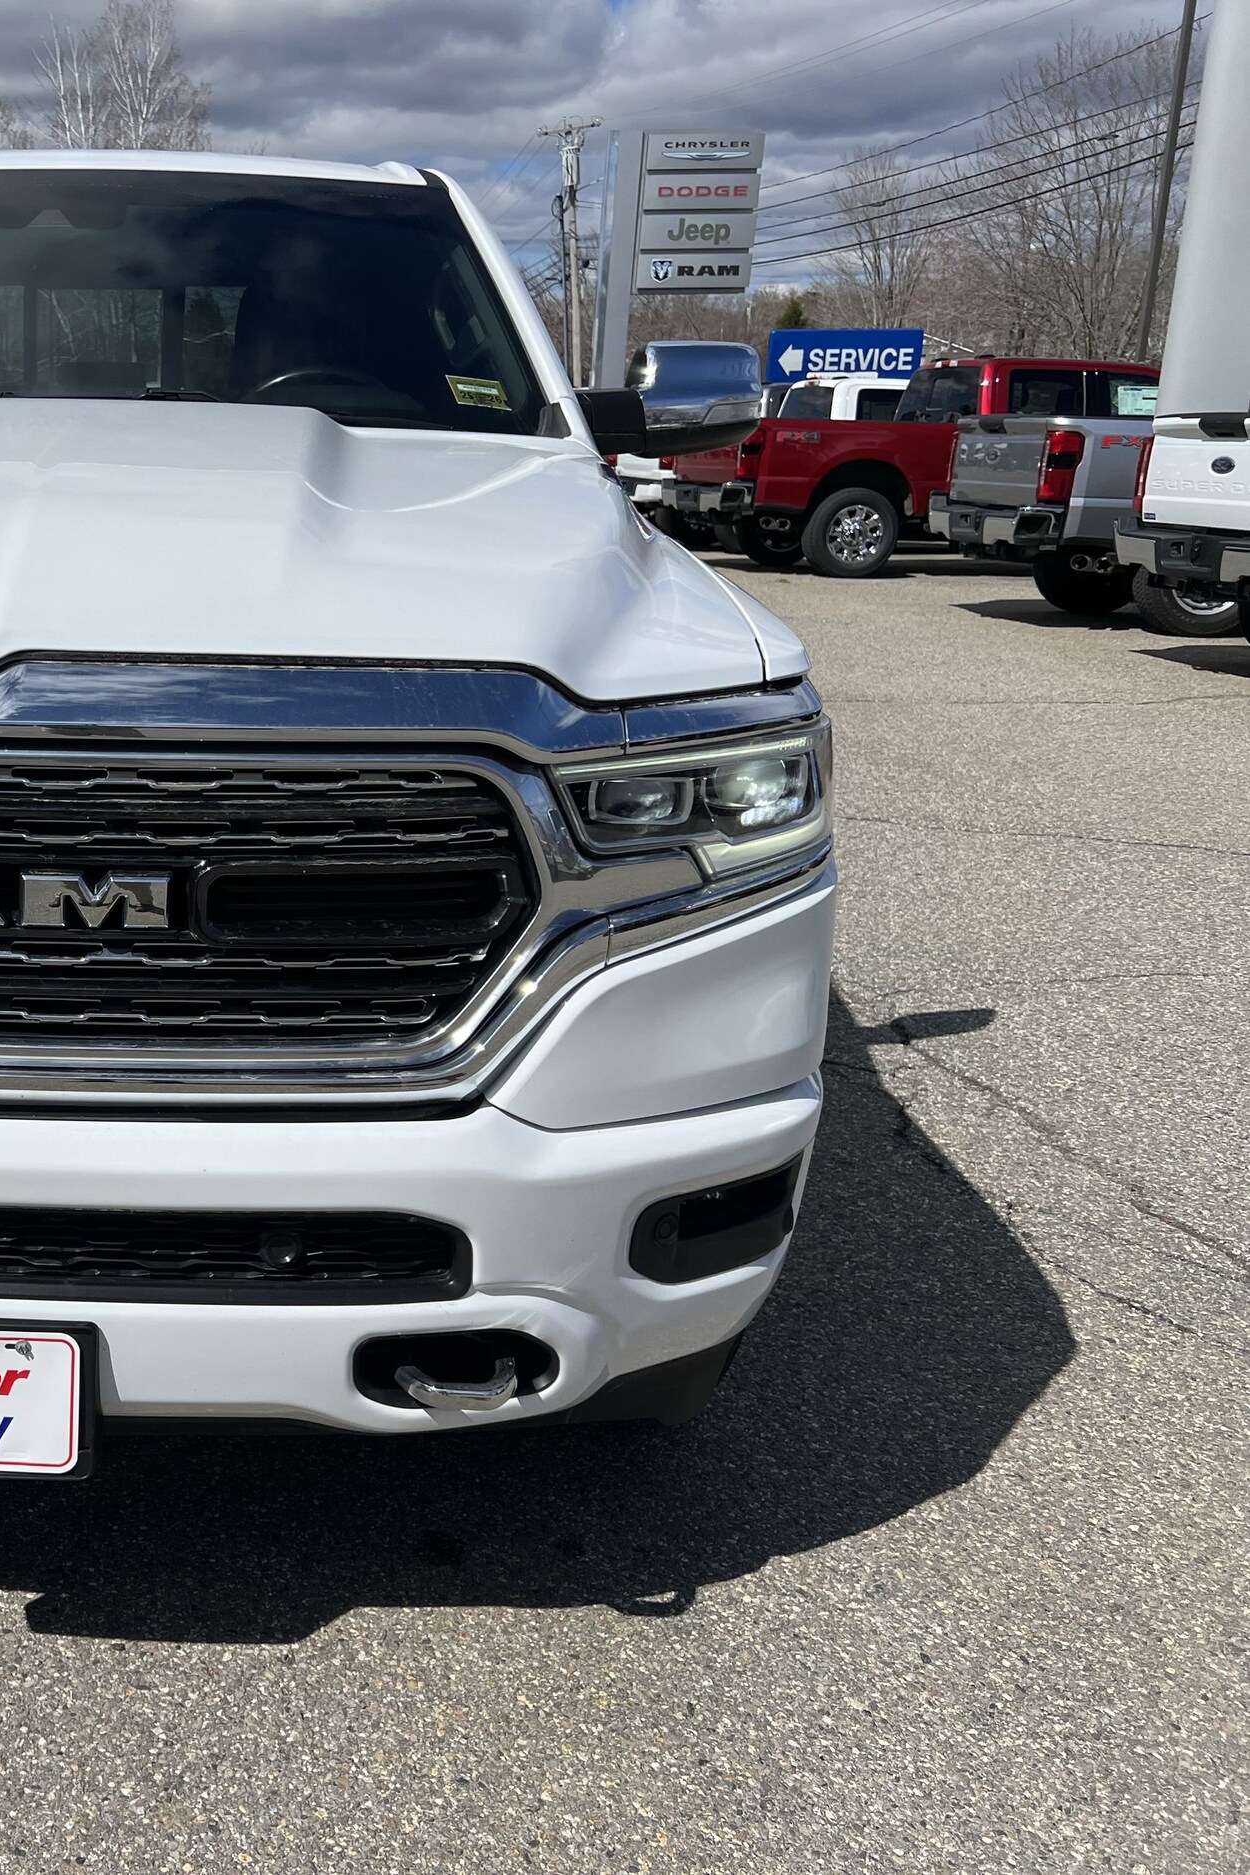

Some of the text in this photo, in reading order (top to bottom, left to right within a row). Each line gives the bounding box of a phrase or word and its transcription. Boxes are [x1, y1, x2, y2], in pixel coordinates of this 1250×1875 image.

[664, 141, 750, 149] CHRYSLER
[658, 185, 749, 198] DODGE
[667, 218, 731, 245] Jeep
[677, 265, 740, 277] RAM
[807, 347, 914, 372] SERVICE
[776, 431, 820, 442] FX4
[1101, 434, 1142, 449] FX
[1151, 478, 1250, 494] SUPER D
